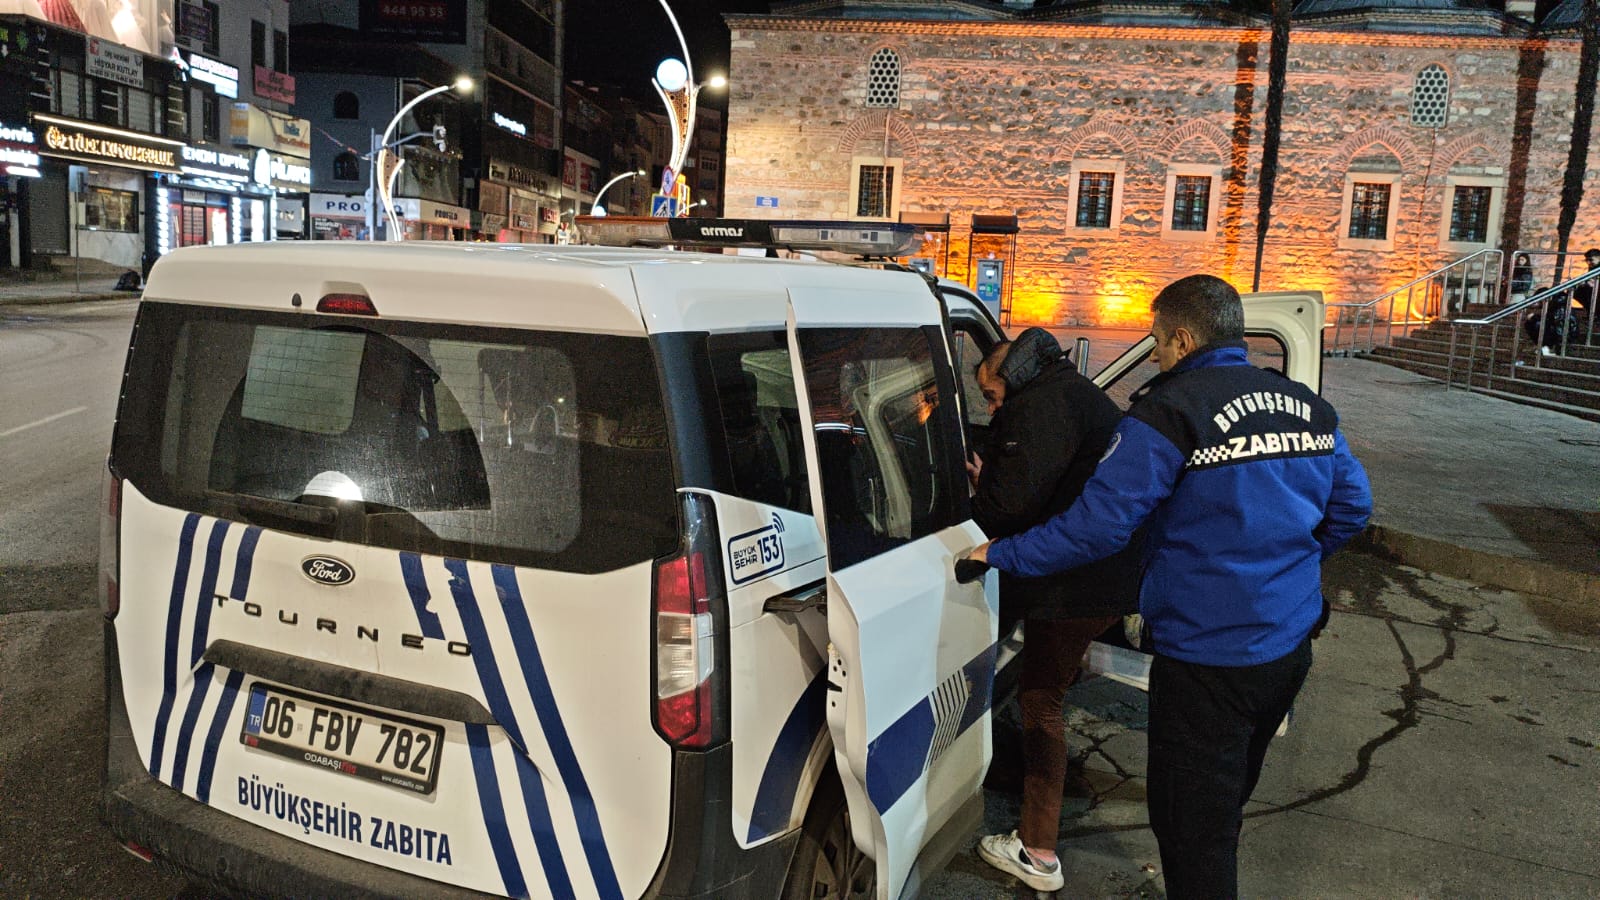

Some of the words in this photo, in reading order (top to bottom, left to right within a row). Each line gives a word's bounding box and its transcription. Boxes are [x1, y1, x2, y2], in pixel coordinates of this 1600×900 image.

[700, 226, 744, 237] armas
[1229, 431, 1317, 459] ZABITA
[733, 545, 757, 560] BÜYÜK
[757, 533, 780, 565] 153
[308, 559, 343, 583] Ford
[734, 554, 758, 571] ŞEHİR
[213, 594, 472, 656] TOURNEO
[250, 713, 261, 728] TR
[262, 696, 296, 739] 06
[308, 707, 363, 756] FBV
[375, 723, 432, 776] 782
[238, 773, 362, 844] BÜYÜKŞEHİR
[370, 816, 453, 866] ZABITA
